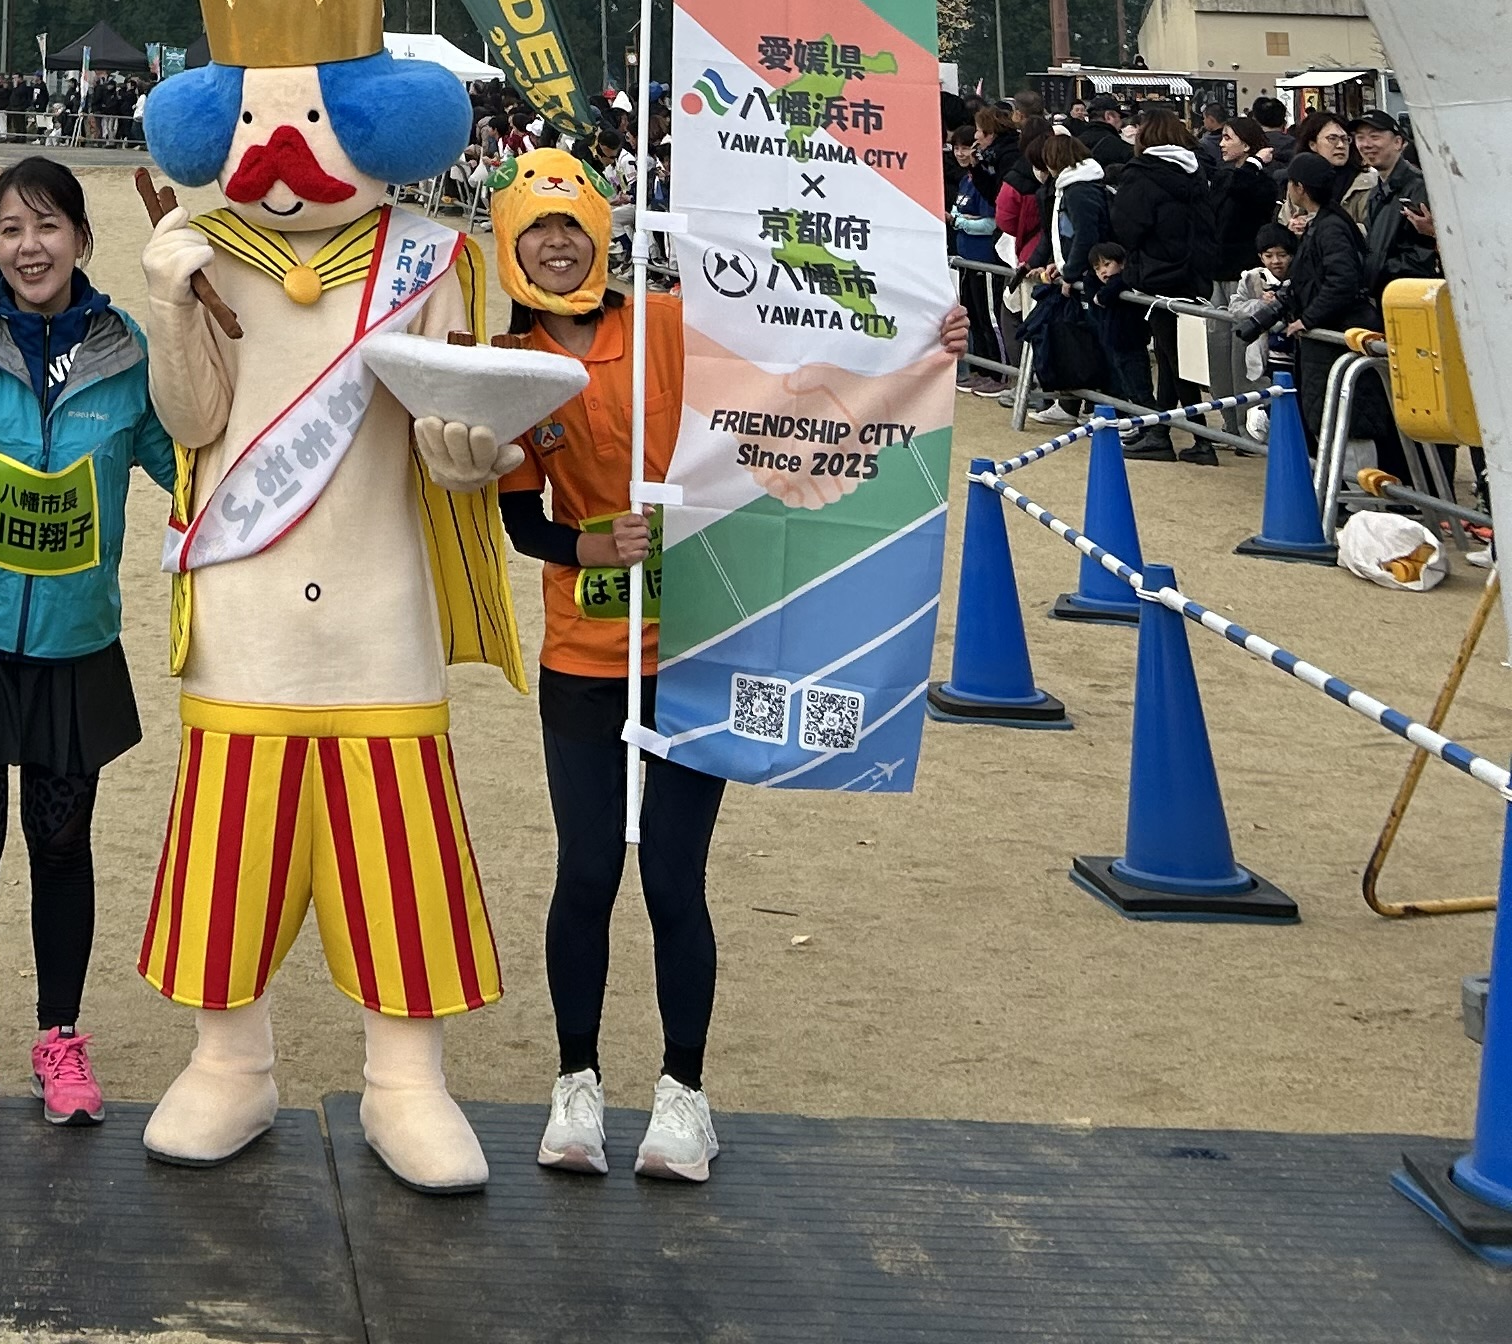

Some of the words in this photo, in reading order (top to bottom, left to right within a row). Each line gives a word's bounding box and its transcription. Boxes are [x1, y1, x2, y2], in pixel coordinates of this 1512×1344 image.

[757, 35, 866, 81] 愛媛県
[738, 86, 886, 135] 八幡浜市
[717, 130, 858, 165] YAWATAHAMA
[863, 148, 908, 170] CITY
[757, 207, 871, 250] 京都府
[766, 258, 878, 299] 八幡市
[756, 304, 843, 330] YAWATA
[850, 312, 896, 335] CITY
[709, 409, 851, 445] FRIENDSHIP
[858, 423, 916, 449] CITY
[736, 443, 802, 473] Since
[810, 452, 879, 480] 2025
[0, 482, 79, 516] 八幡市長
